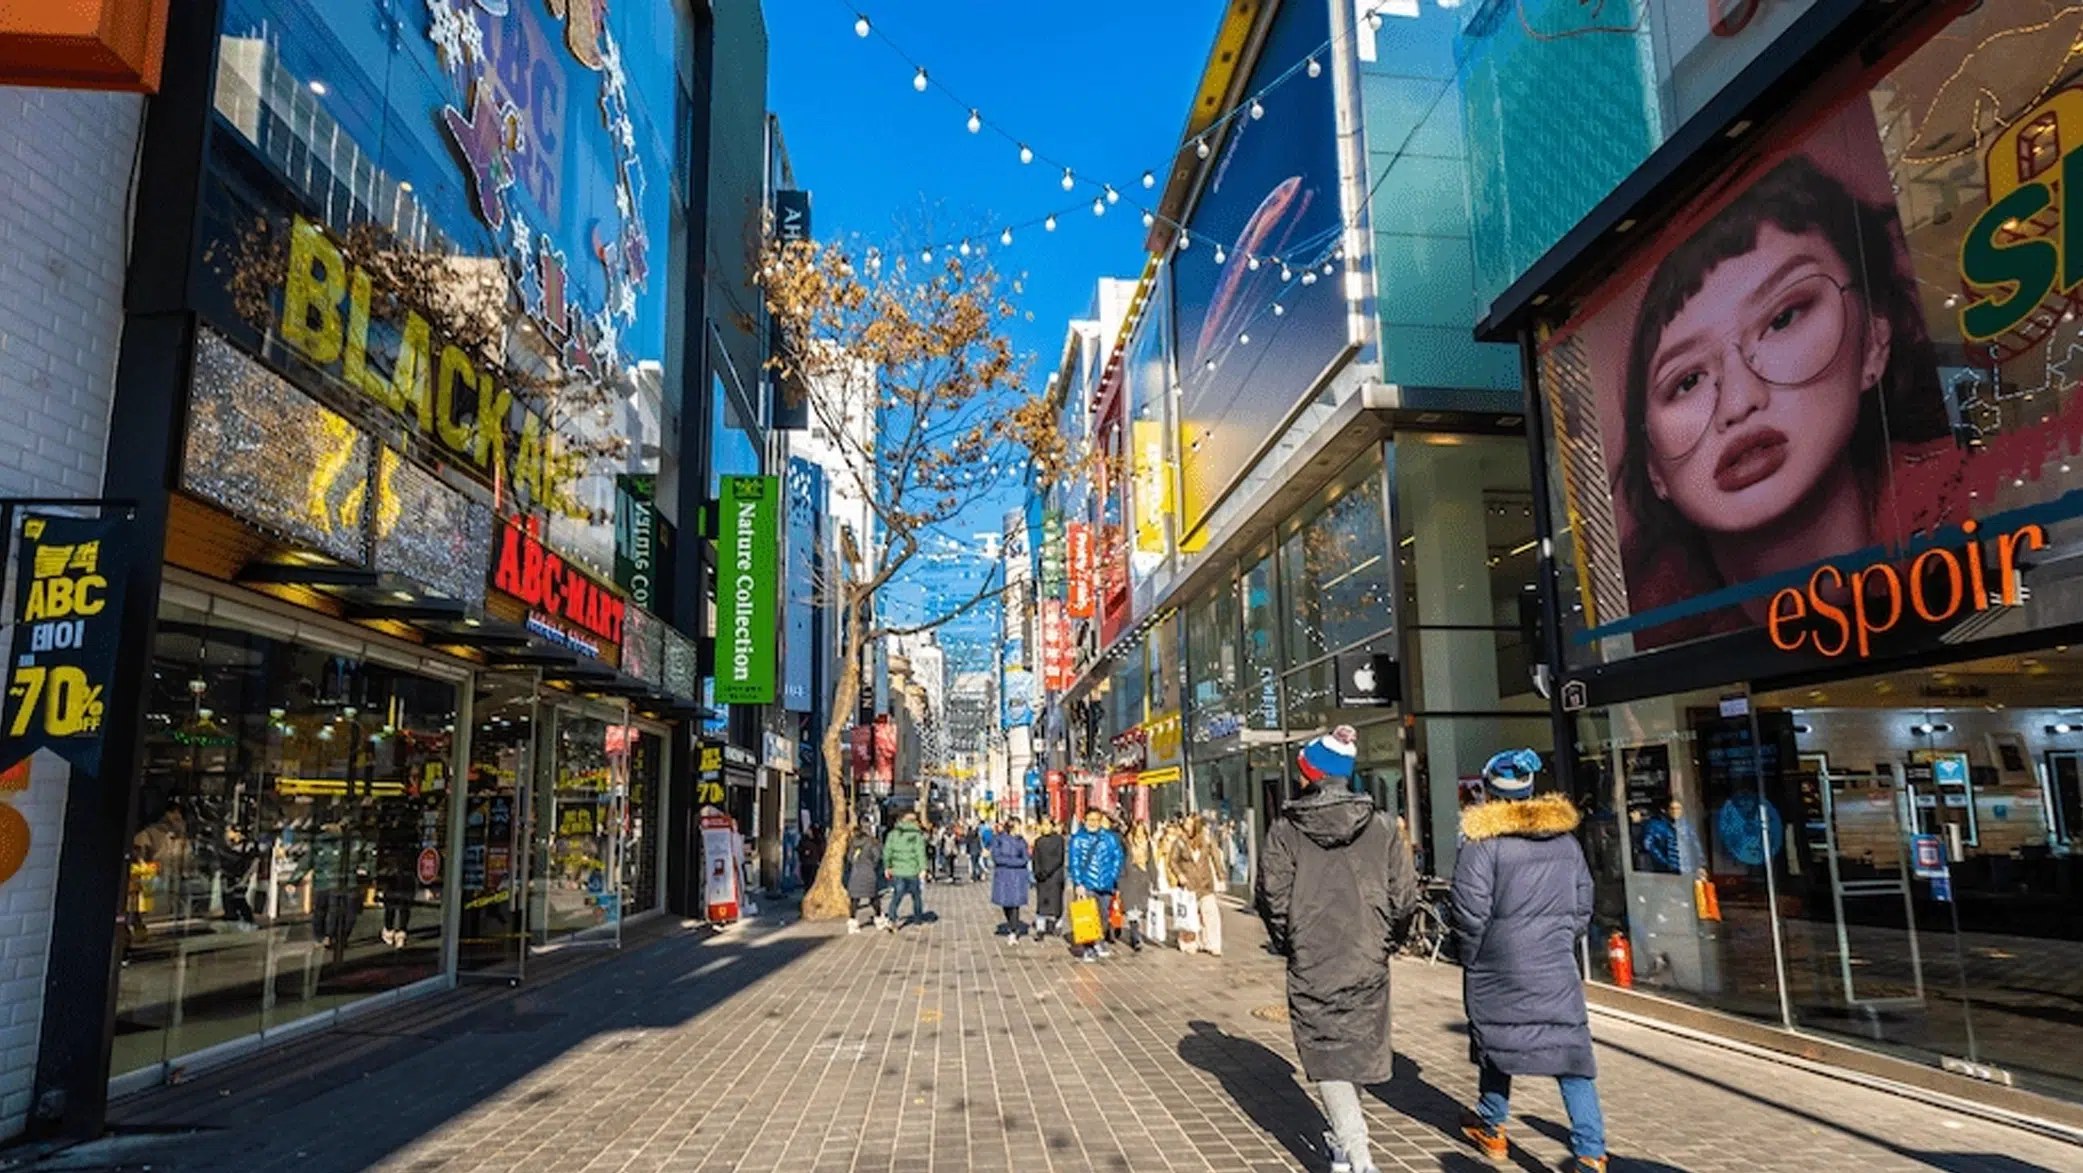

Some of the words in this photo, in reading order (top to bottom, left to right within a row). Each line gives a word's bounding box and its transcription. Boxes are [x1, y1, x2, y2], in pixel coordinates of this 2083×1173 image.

[281, 213, 512, 480] BLACK
[496, 523, 627, 646] ABC-MART
[735, 502, 756, 570] Nature
[25, 576, 107, 622] ABC
[734, 574, 754, 682] Collection
